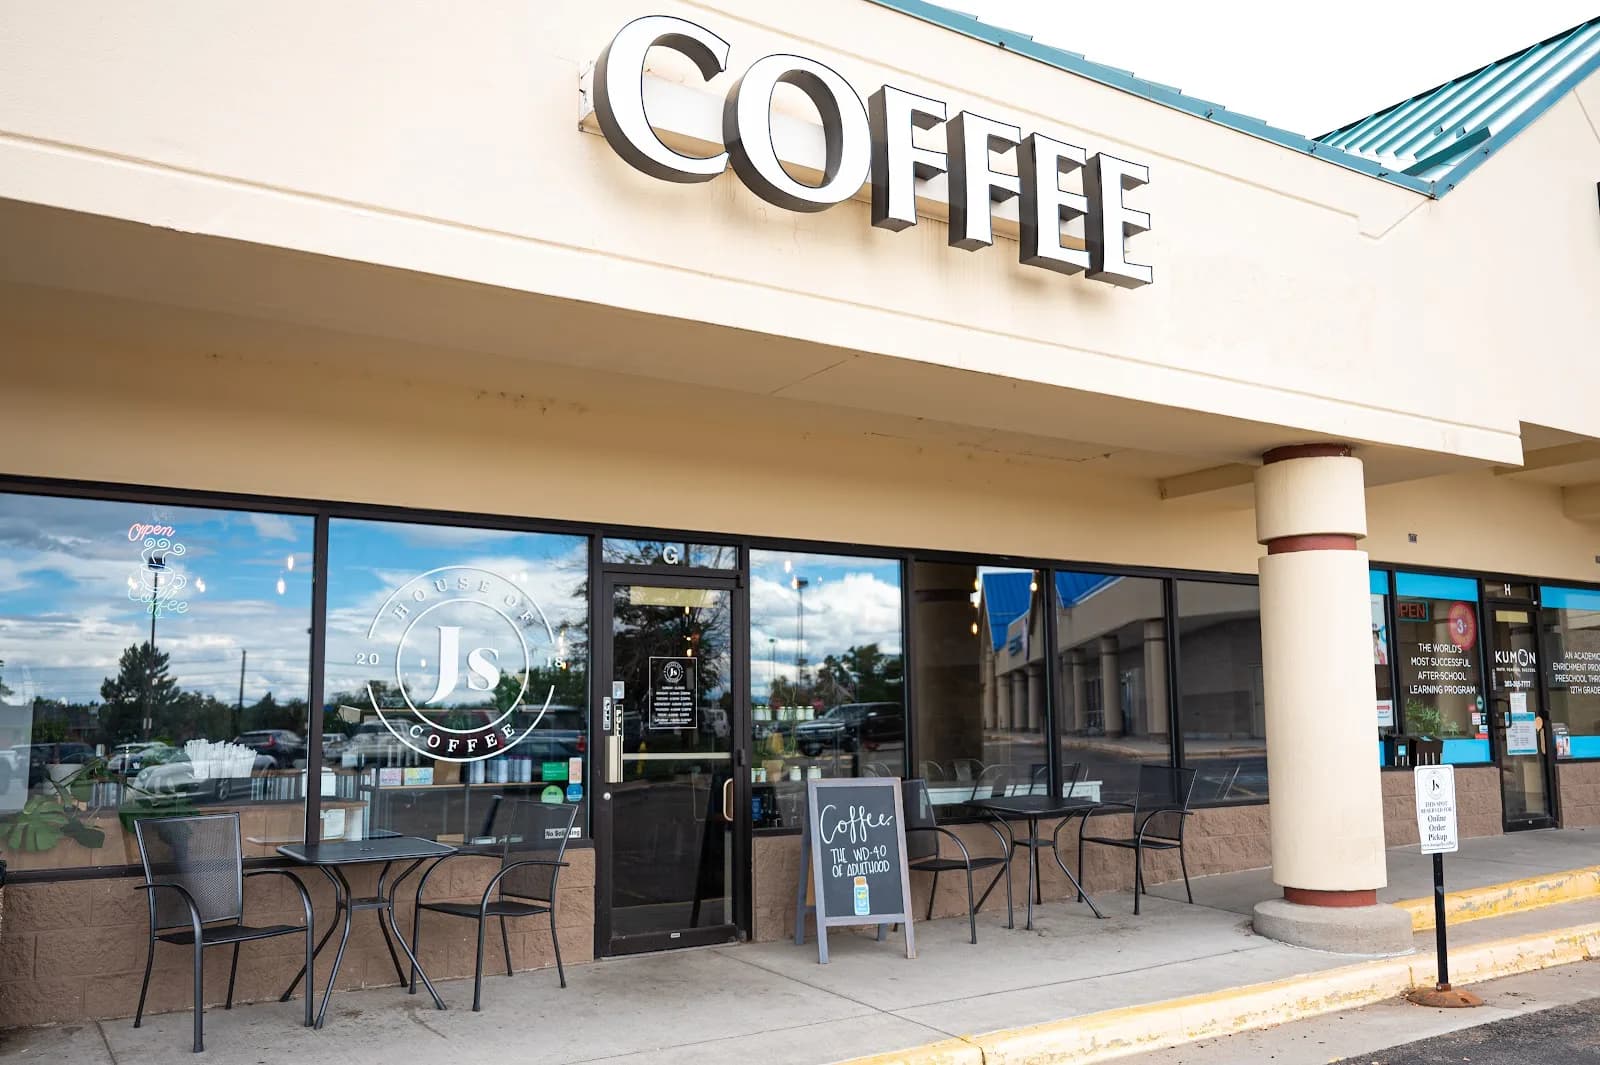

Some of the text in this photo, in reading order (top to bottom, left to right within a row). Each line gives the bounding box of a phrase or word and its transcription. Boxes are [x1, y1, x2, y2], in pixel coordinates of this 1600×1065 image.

[593, 15, 1153, 289] COFFEE
[128, 523, 176, 541] Open
[663, 546, 679, 565] G
[1504, 583, 1511, 596] H
[391, 577, 535, 626] HOUSE OF
[1418, 643, 1462, 654] THE WORLD'S
[356, 653, 380, 665] 20
[1495, 648, 1536, 667] KUMON
[1564, 651, 1573, 660] AN
[425, 625, 501, 705] Js
[547, 656, 563, 667] 18
[1411, 657, 1471, 668] MOST SUCCESSFUL
[1553, 662, 1587, 672] ENRICHMENT
[1418, 671, 1467, 681] AFTER-SCHOOL
[1555, 674, 1587, 683] PRESCHOOL
[1410, 685, 1476, 695] LEARNING PROGRAM
[1570, 685, 1582, 695] 12TH
[409, 723, 515, 752] COFFEE
[1427, 814, 1446, 823] Online
[1428, 824, 1446, 832] Order
[1428, 833, 1448, 842] Pickup
[830, 844, 887, 864] THE WD-40
[832, 860, 890, 878] OF ADULTHOOD
